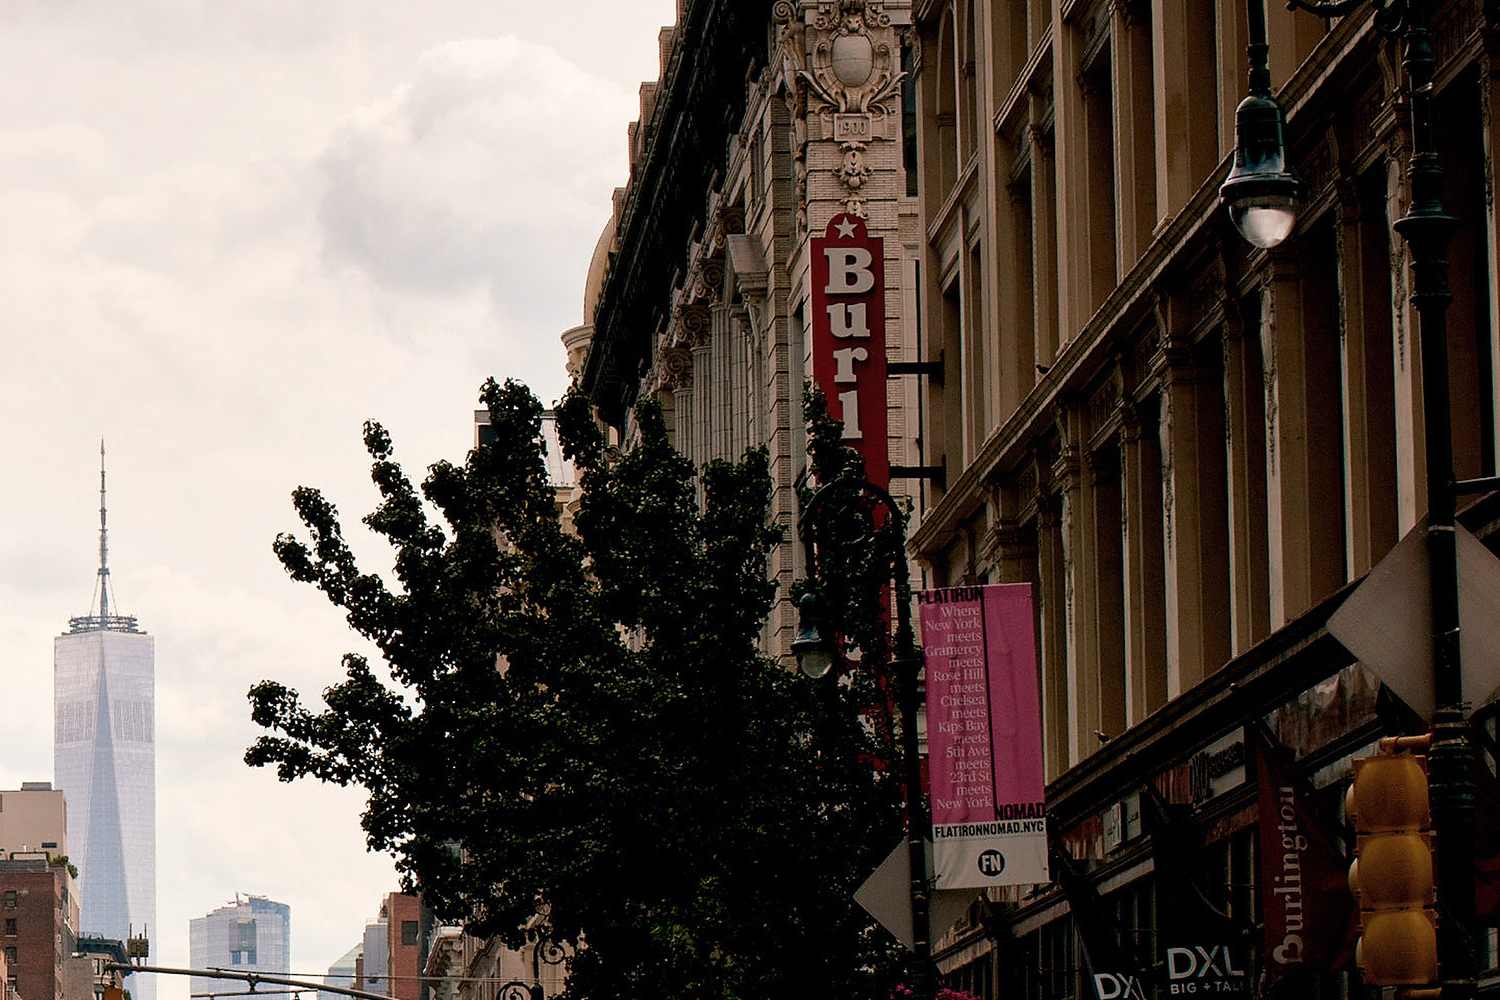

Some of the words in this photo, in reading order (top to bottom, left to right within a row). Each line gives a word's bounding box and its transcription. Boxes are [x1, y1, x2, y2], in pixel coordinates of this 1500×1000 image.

[838, 120, 867, 135] 1900
[941, 606, 980, 617] Where
[925, 620, 950, 632] New
[955, 617, 981, 630] York
[947, 631, 982, 642] meets
[924, 645, 982, 657] Gramercy
[949, 658, 984, 668] meets
[933, 671, 961, 681] Rose
[963, 668, 984, 680] Hill
[950, 682, 985, 693] meets
[940, 694, 985, 707] Chelsea
[952, 708, 987, 719] meets
[938, 722, 964, 735] Kips
[966, 720, 987, 732] Bay
[954, 733, 989, 744] meets
[945, 747, 965, 758] 5th
[968, 746, 989, 757] Ave
[955, 758, 990, 770] meets
[950, 771, 977, 783] 23rd
[979, 770, 991, 782] St
[956, 784, 992, 796] meets
[936, 799, 963, 810] New
[965, 796, 993, 809] York
[995, 803, 1046, 821] NOMAD
[934, 820, 1045, 839] FLATIRONNOMAD.NYC
[981, 854, 1001, 872] FN
[1166, 944, 1245, 980] DXL
[1170, 981, 1197, 995] BIG
